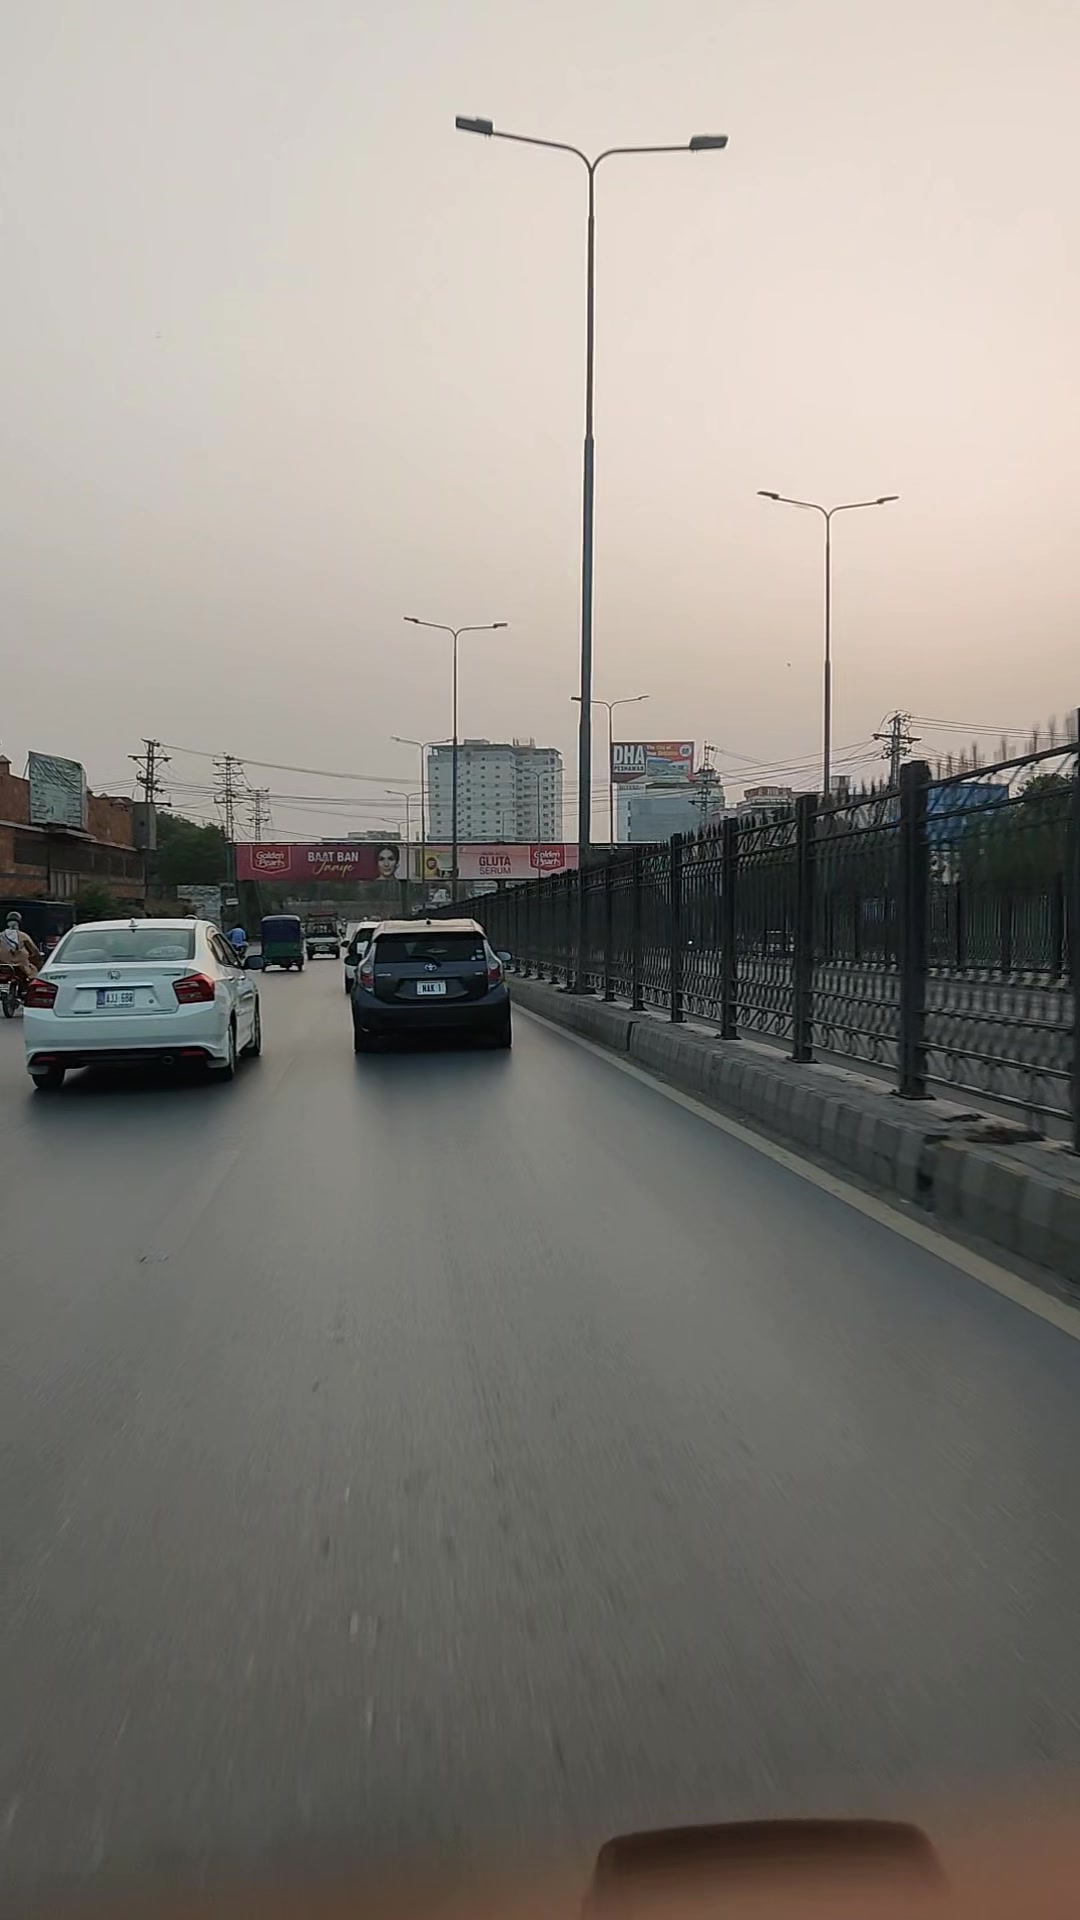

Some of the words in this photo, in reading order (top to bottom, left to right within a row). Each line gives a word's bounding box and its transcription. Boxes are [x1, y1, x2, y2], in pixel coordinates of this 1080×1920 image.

[613, 744, 645, 764] DHA
[613, 764, 645, 772] PESHAWAR
[256, 850, 285, 861] Golden
[307, 851, 335, 862] BAAT
[337, 851, 359, 862] BAN
[533, 850, 561, 861] Golden
[479, 856, 512, 867] GLUTA
[479, 866, 512, 875] SERUM
